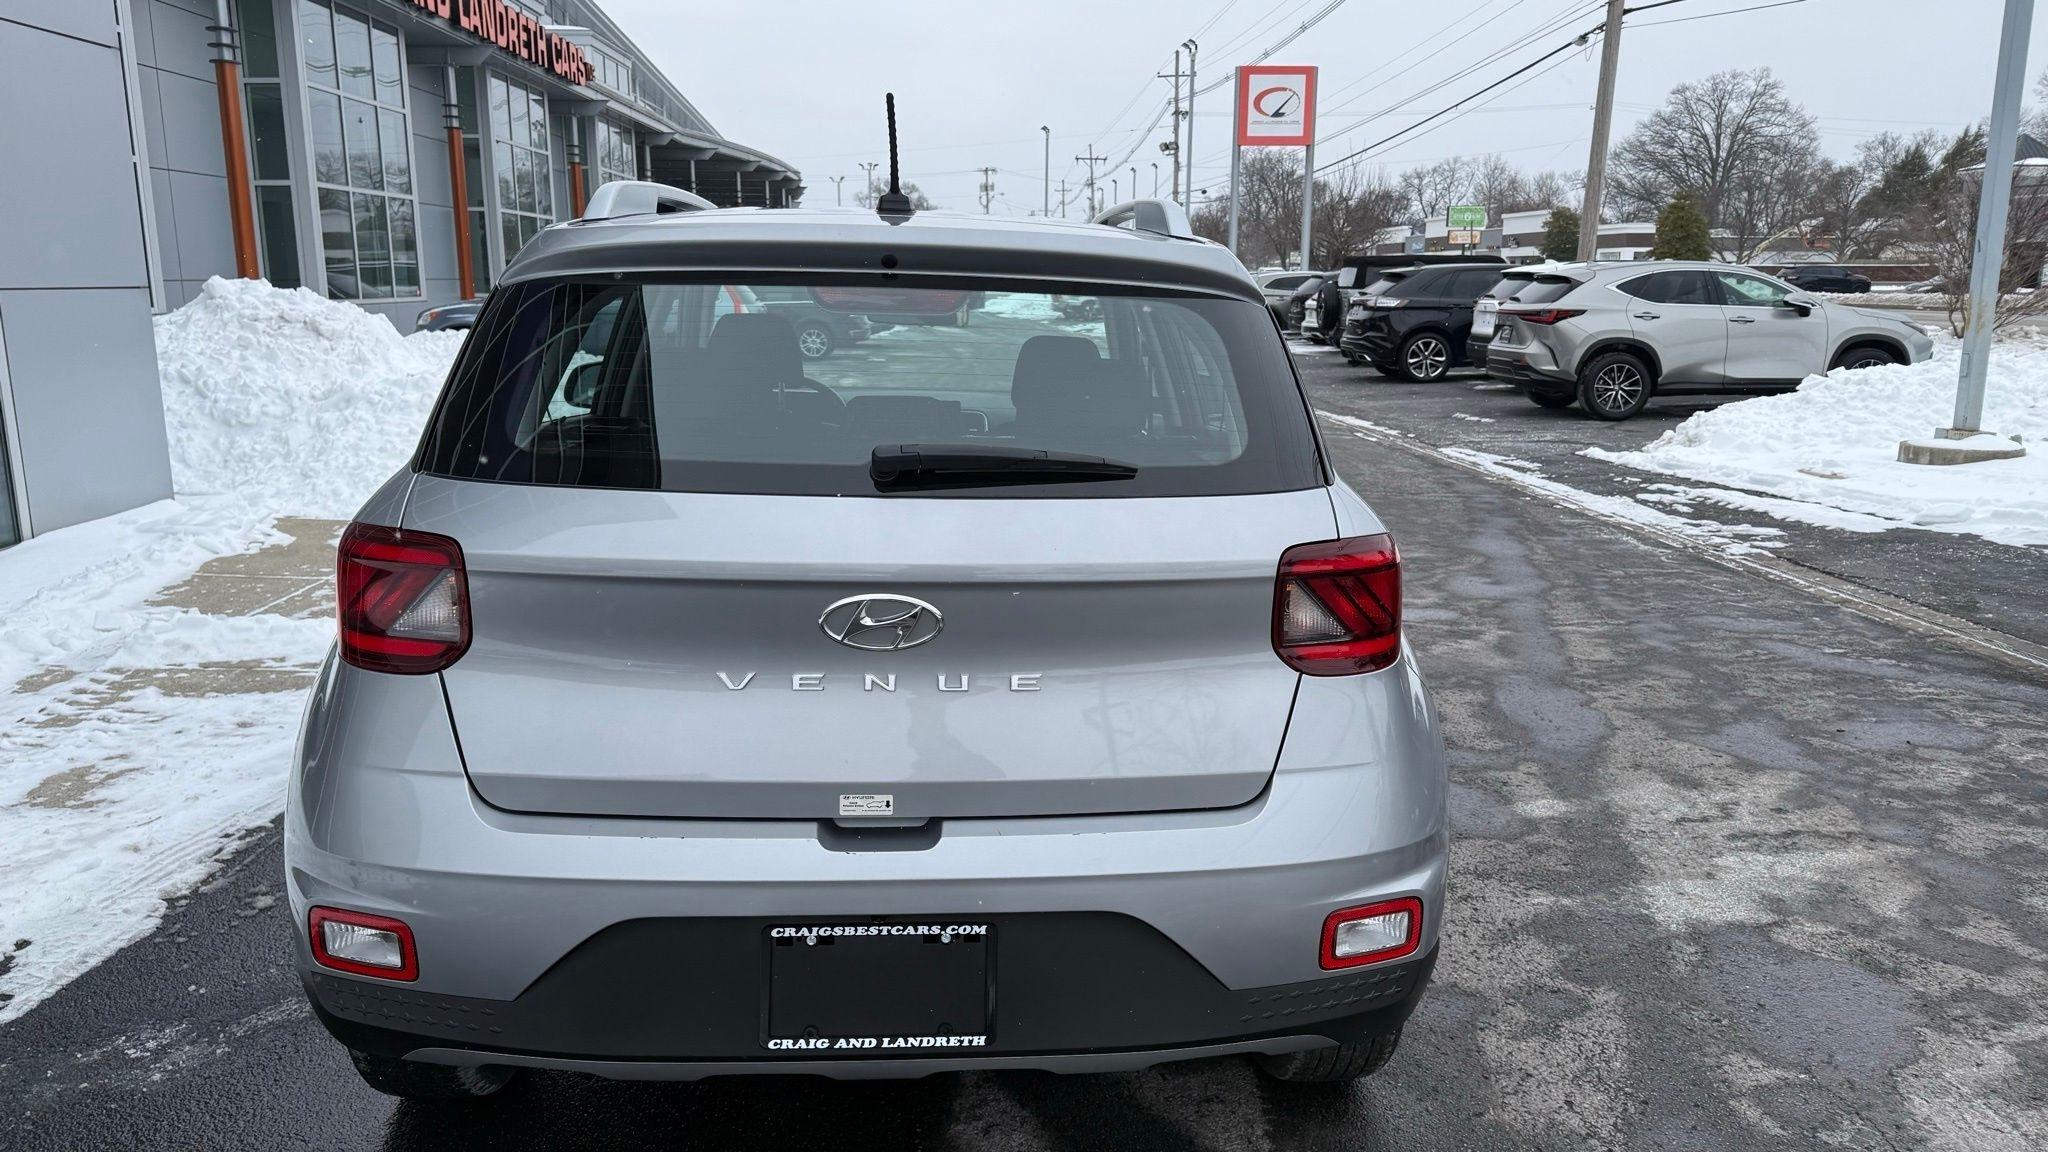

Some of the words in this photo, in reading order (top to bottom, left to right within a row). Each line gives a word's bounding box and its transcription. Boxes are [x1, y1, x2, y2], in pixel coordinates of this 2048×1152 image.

[458, 0, 548, 69] LANDRETH
[551, 32, 586, 86] CARS
[716, 672, 1043, 691] VENUE
[770, 925, 988, 938] CRAIGSBESTCARS.COM
[767, 1038, 830, 1050] CRAIG
[833, 1037, 878, 1049] AND
[881, 1035, 987, 1048] LANDRETH
